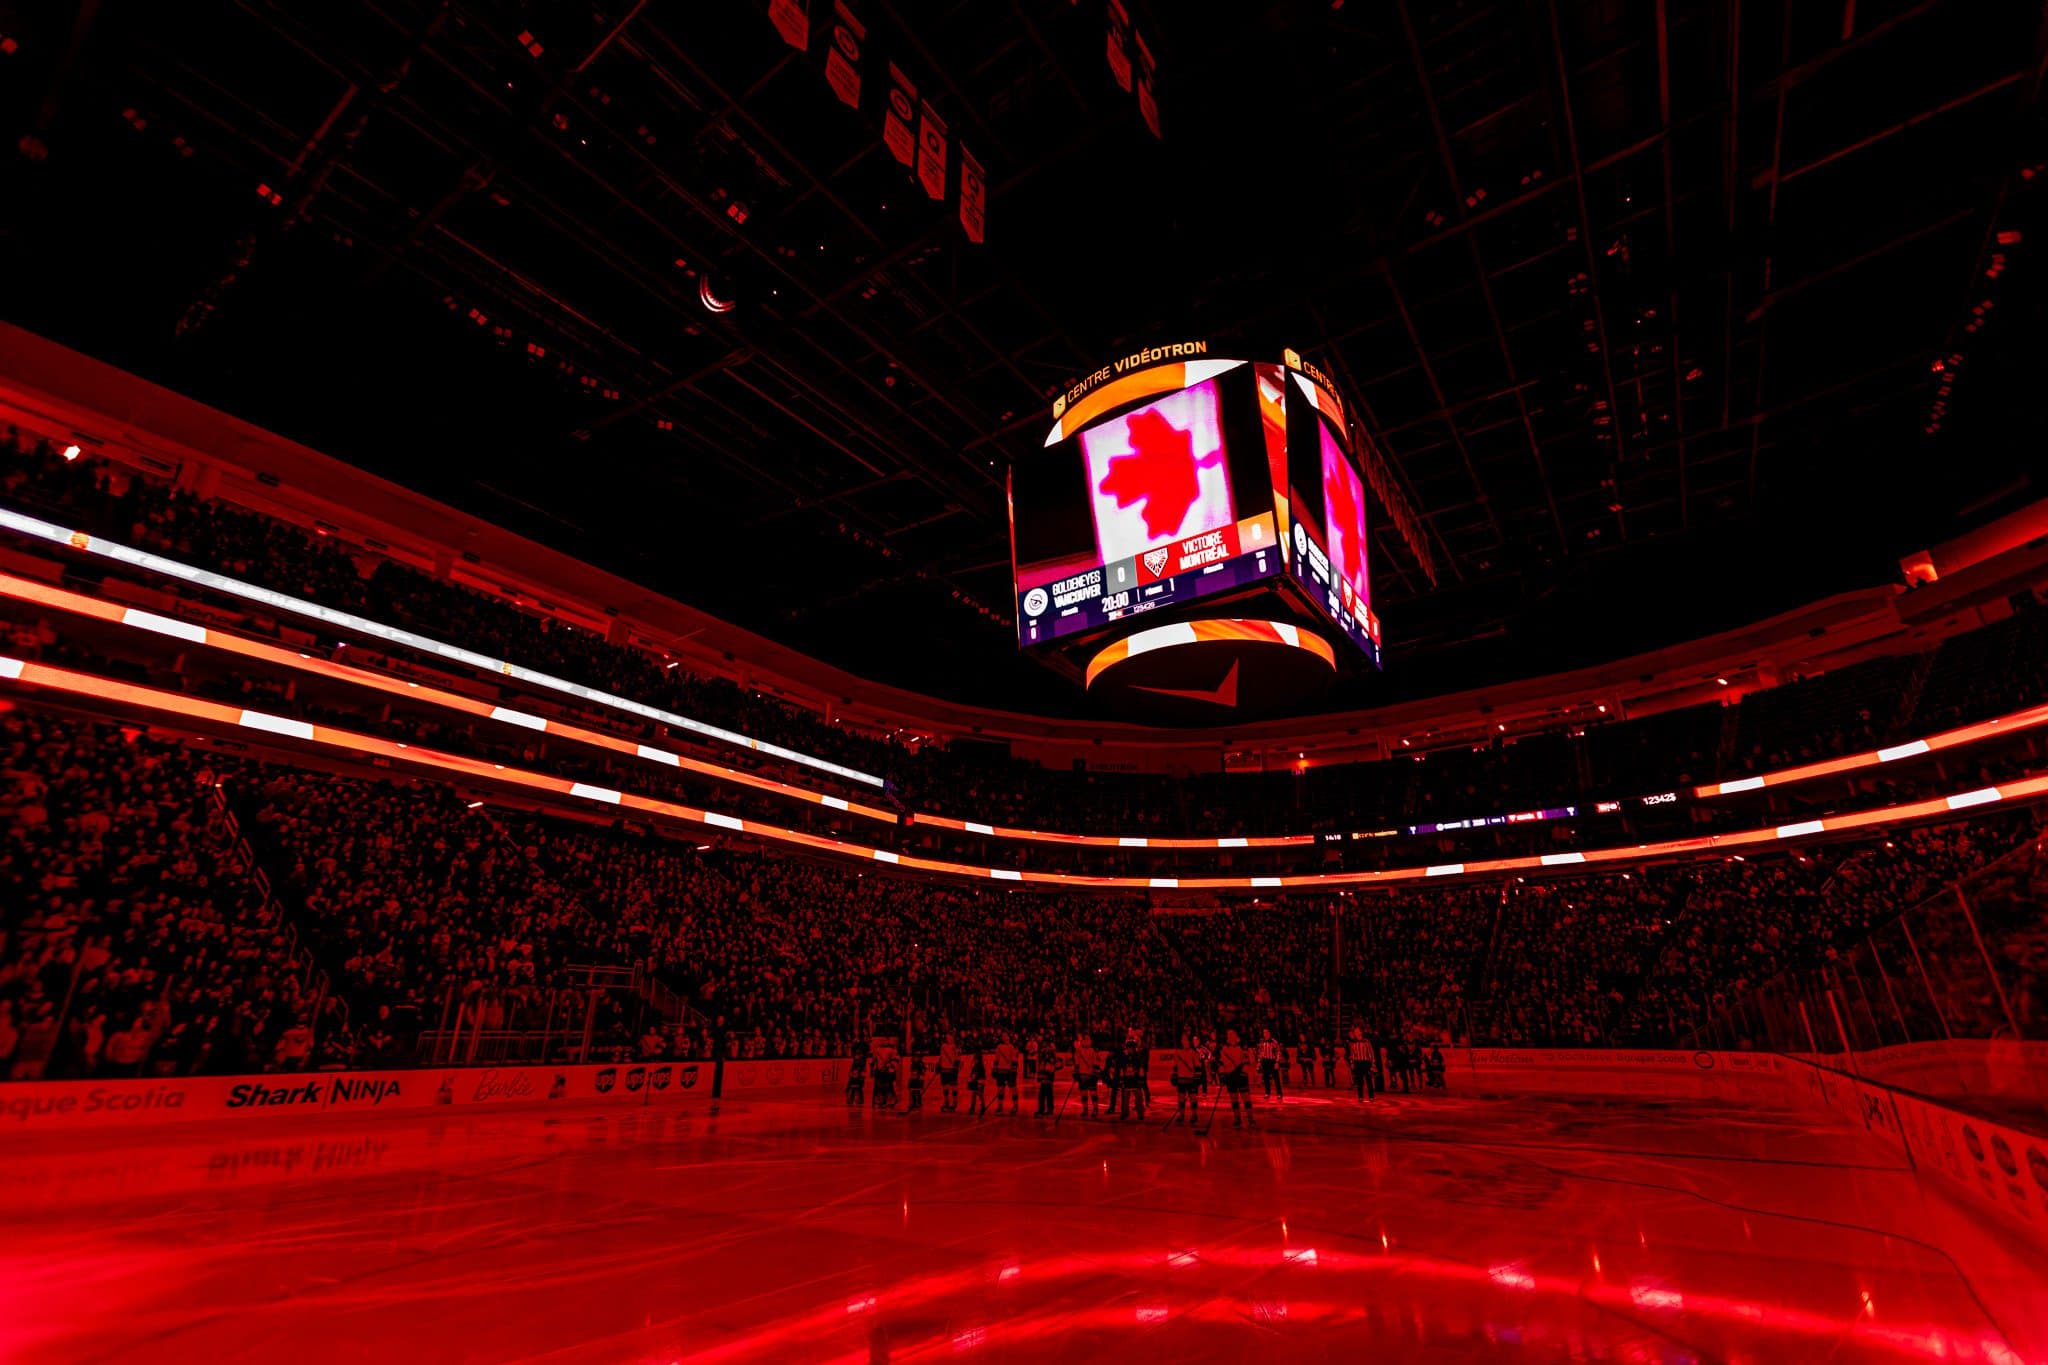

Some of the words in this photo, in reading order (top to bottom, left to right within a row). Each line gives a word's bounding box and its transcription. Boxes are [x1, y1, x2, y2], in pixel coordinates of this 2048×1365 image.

[1067, 366, 1110, 403] CENTRE
[1114, 341, 1207, 373] VIDÉOTRON
[1182, 531, 1223, 554] VICTOIRE
[1180, 544, 1229, 570] MONTRÉAL
[1053, 570, 1101, 596] GOLDENEYES
[1117, 567, 1125, 582] 0
[1054, 584, 1101, 608] VANCOUVER
[1101, 591, 1129, 612] 20:00
[82, 1085, 187, 1112] Scotia
[226, 1082, 323, 1108] Shark
[330, 1077, 401, 1104] NINJA
